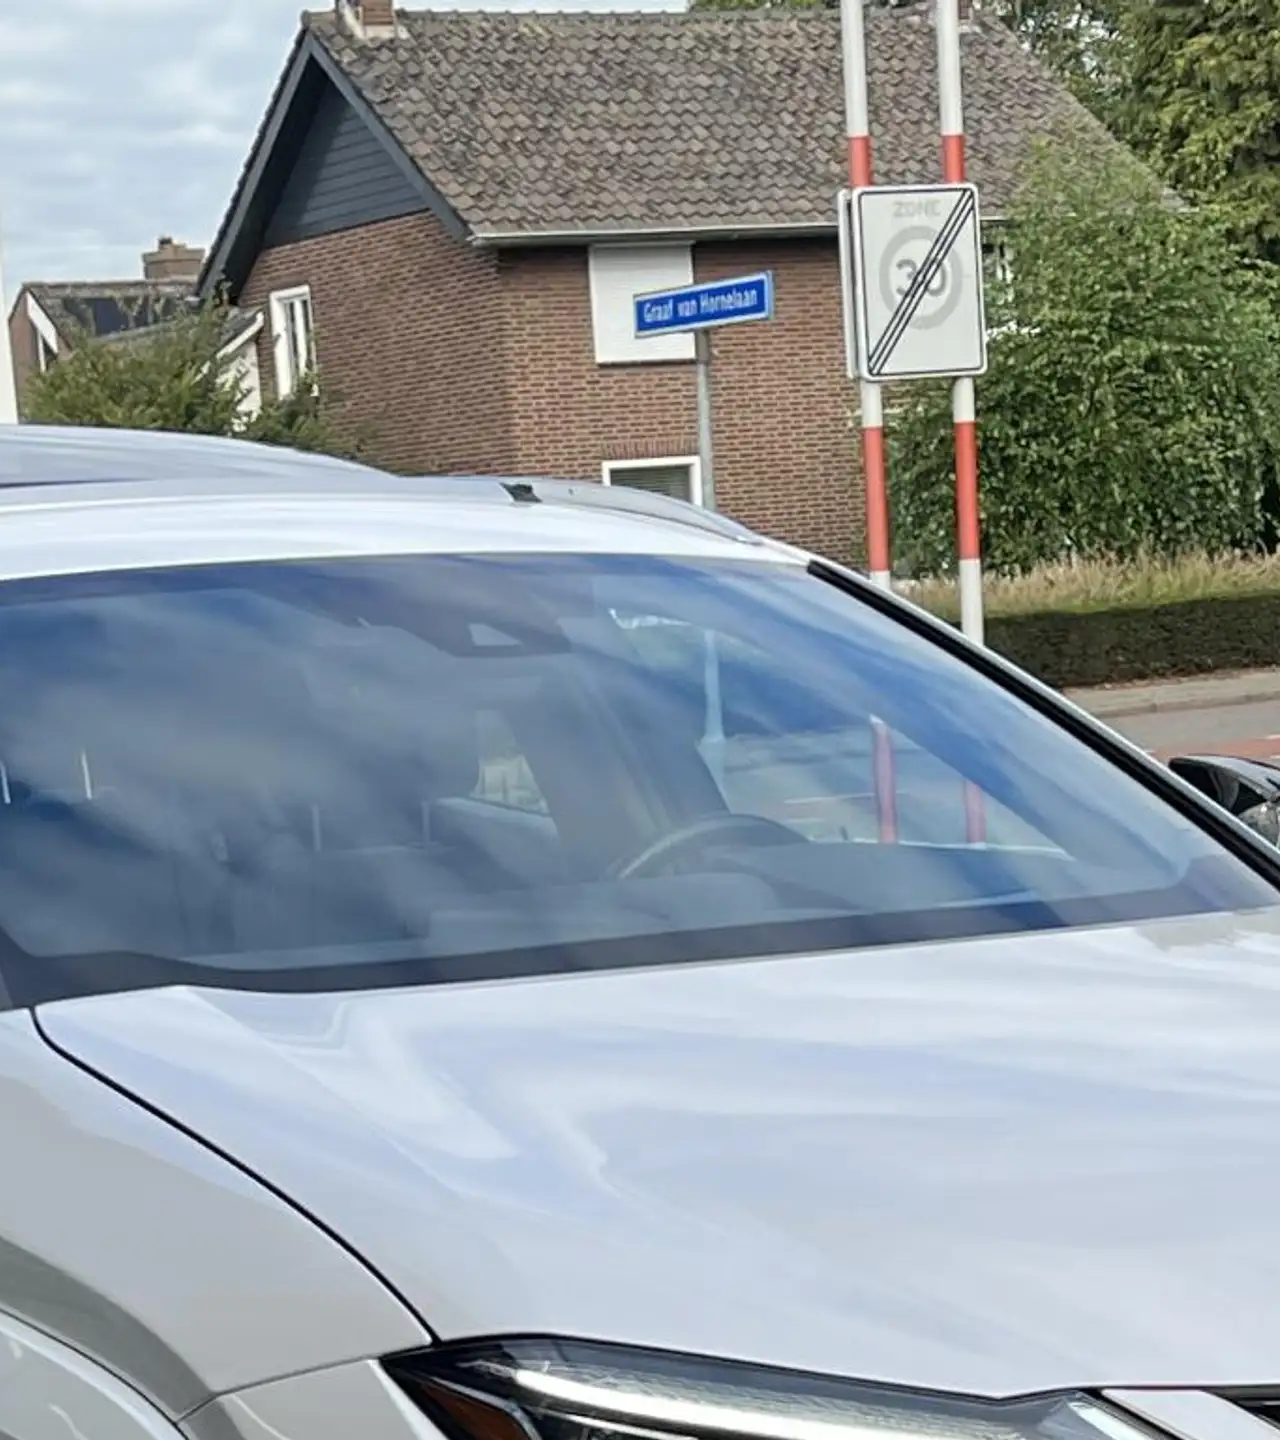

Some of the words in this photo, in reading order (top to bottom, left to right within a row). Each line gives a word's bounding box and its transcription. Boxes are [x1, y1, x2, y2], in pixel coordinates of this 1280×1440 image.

[896, 259, 947, 297] 30
[644, 298, 674, 323] Graaf
[677, 299, 698, 317] van
